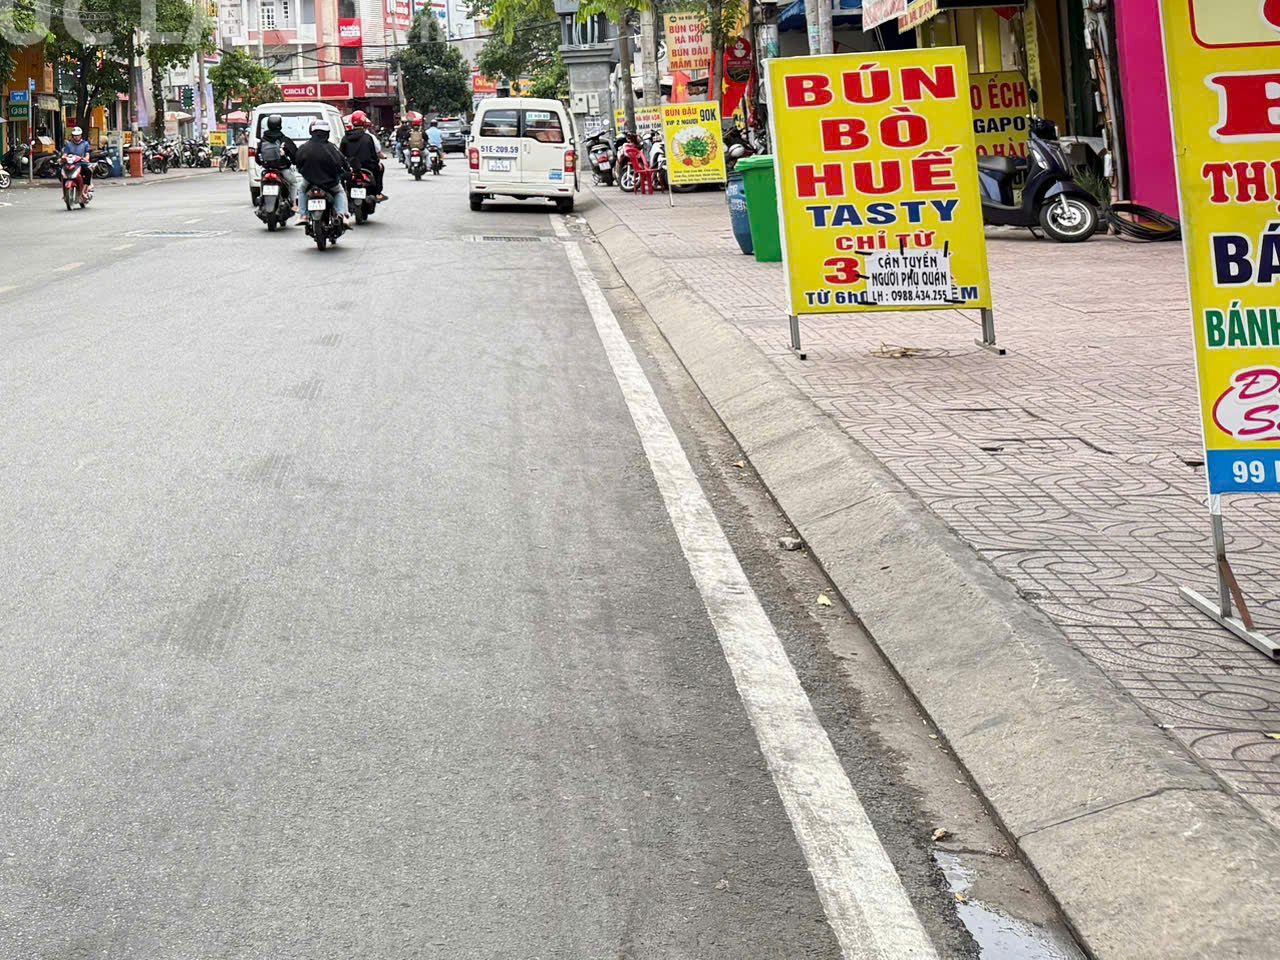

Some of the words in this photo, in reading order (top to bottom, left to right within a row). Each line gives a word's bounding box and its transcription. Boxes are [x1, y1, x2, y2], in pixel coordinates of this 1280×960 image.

[785, 62, 958, 108] BÚN
[988, 73, 1027, 110] ẾCH
[700, 108, 716, 121] 90K
[820, 106, 929, 152] BÒ
[795, 146, 960, 198] HUẾ
[806, 199, 960, 227] TASTY
[835, 230, 888, 251] CHỈ
[895, 231, 936, 249] TỪ
[872, 271, 899, 287] NGƯỜI
[922, 269, 947, 287] QUÁN
[805, 288, 830, 305] TỪ
[872, 290, 884, 302] LH
[891, 290, 947, 302] 0988.434.255
[1232, 460, 1265, 483] 99
